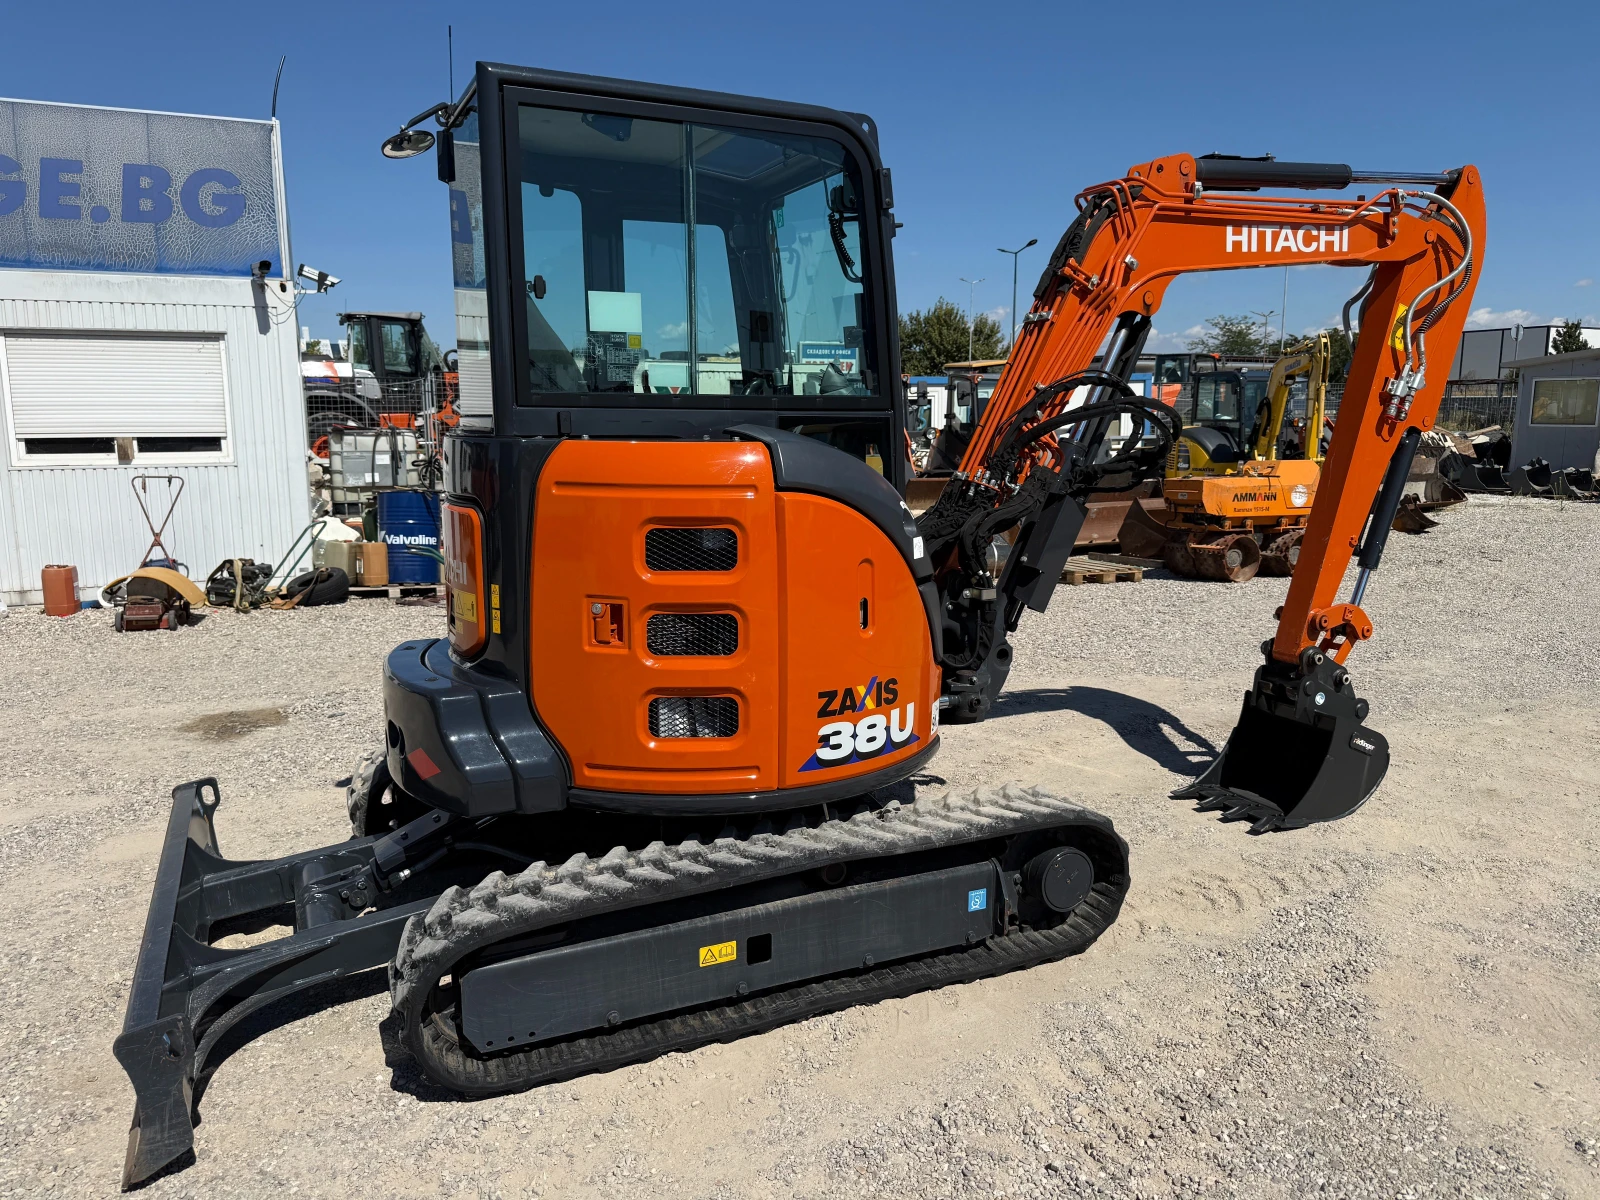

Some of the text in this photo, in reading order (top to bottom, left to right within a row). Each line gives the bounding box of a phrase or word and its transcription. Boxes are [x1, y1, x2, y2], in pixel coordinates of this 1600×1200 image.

[1226, 225, 1349, 252] HITACHI
[1232, 492, 1277, 502] AMMANN
[385, 534, 437, 546] Valvoline
[817, 676, 898, 718] ZAXIS
[816, 702, 914, 766] 38U
